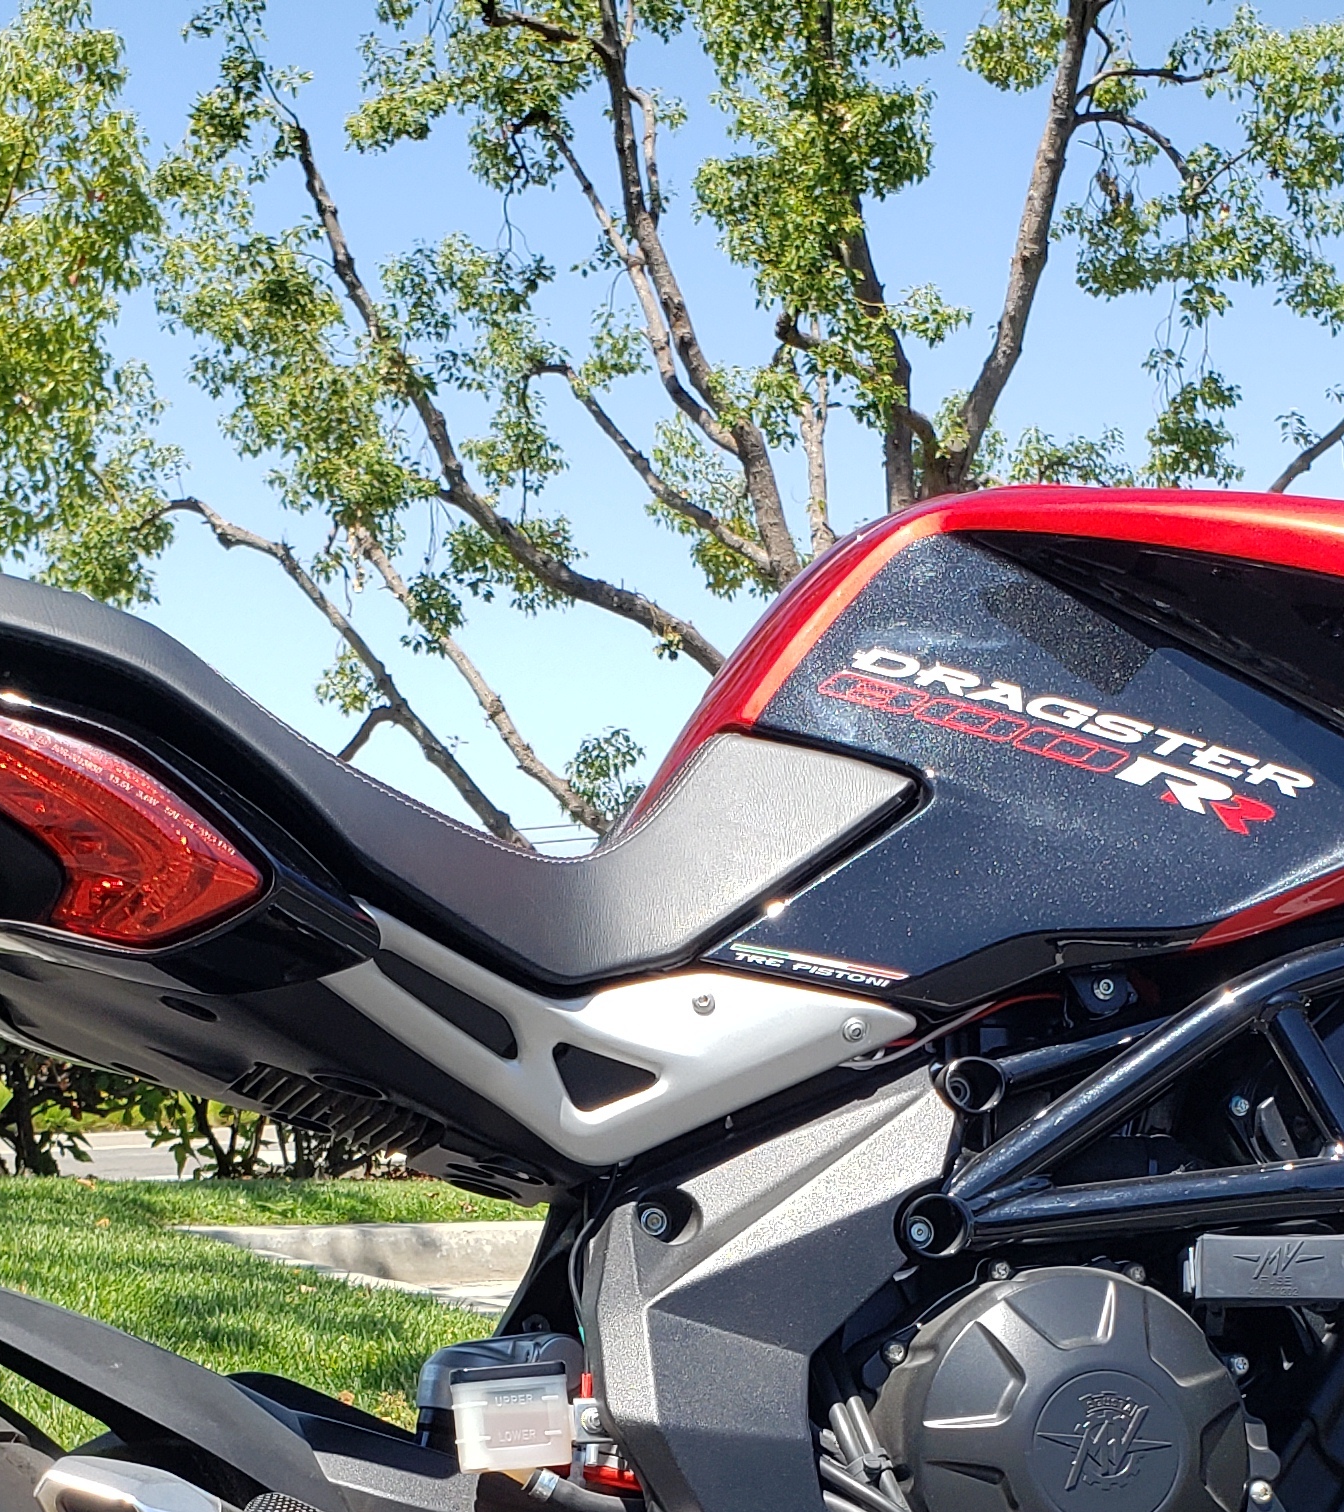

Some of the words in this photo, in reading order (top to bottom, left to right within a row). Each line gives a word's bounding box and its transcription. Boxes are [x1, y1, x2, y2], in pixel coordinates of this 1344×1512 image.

[852, 645, 1316, 798] DRAGSTER
[735, 951, 785, 968] TRE
[792, 962, 890, 988] PISTONI
[495, 1394, 534, 1407] UPPER
[498, 1428, 537, 1442] LOWER
